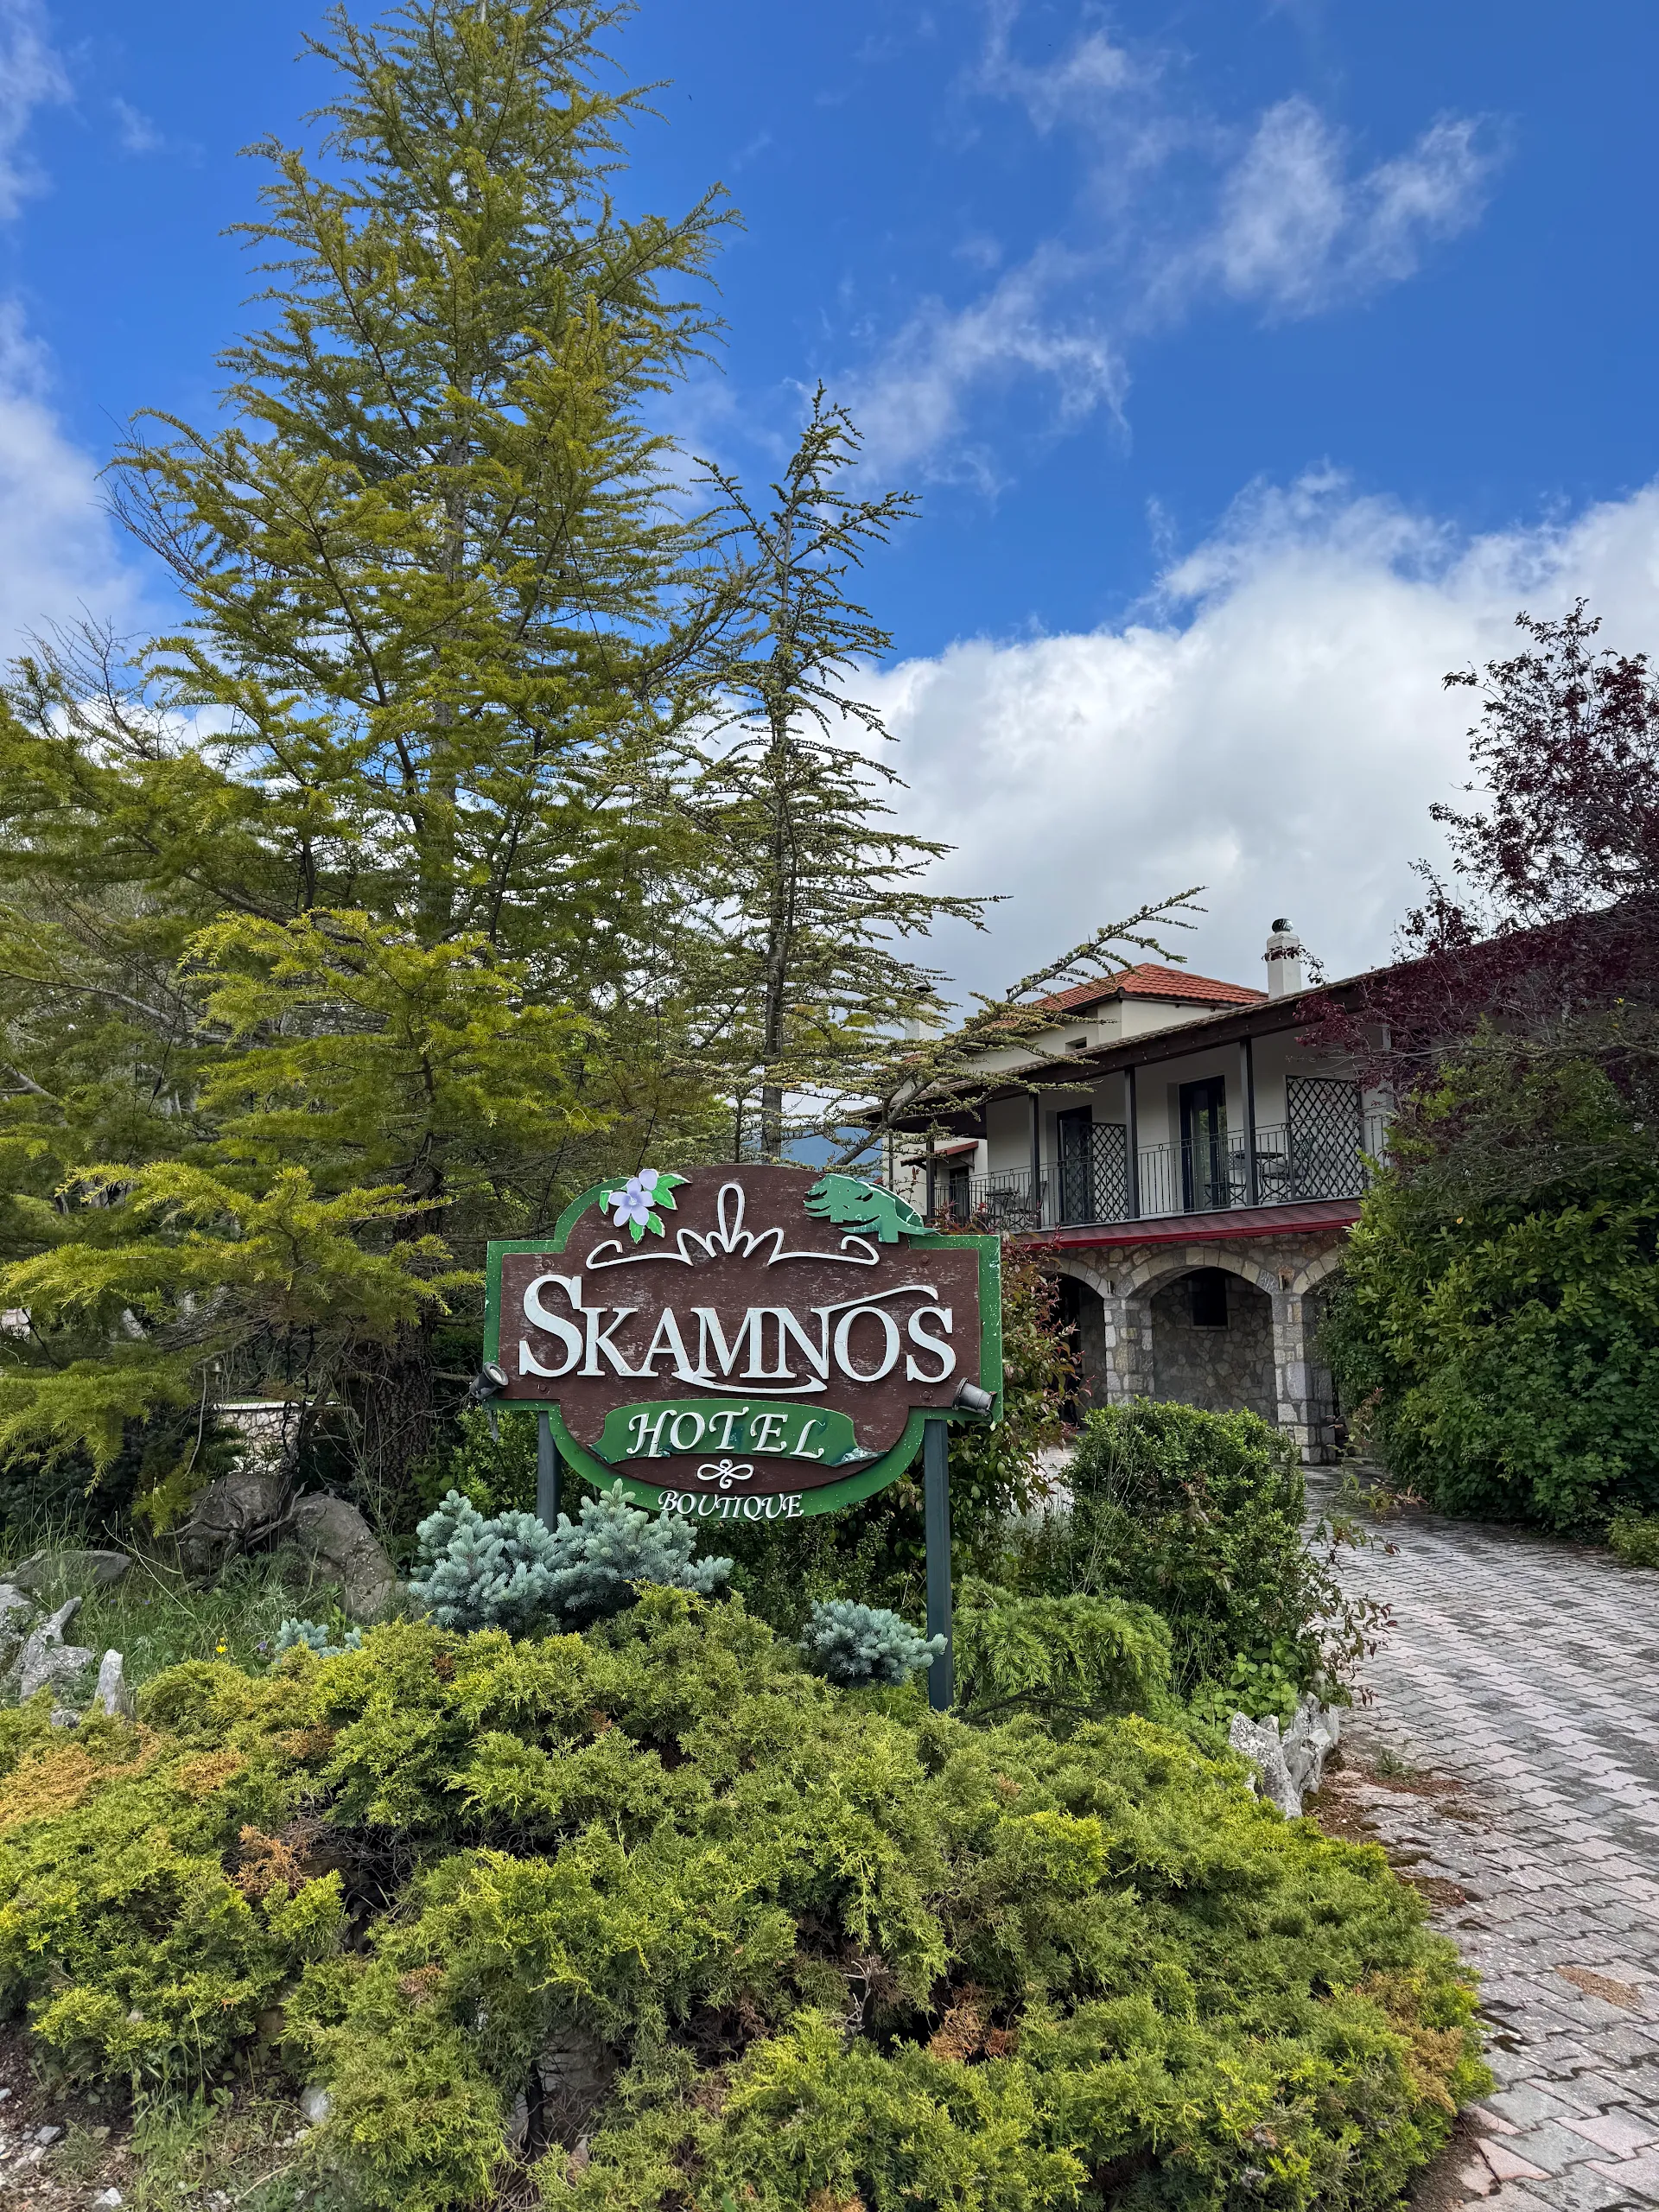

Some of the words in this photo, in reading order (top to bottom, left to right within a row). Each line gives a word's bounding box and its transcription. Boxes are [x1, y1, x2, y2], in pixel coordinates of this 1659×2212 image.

[518, 1274, 957, 1394] SKAMNOS
[626, 1406, 826, 1459] HOTEL
[658, 1490, 805, 1521] BOUTIQUE
